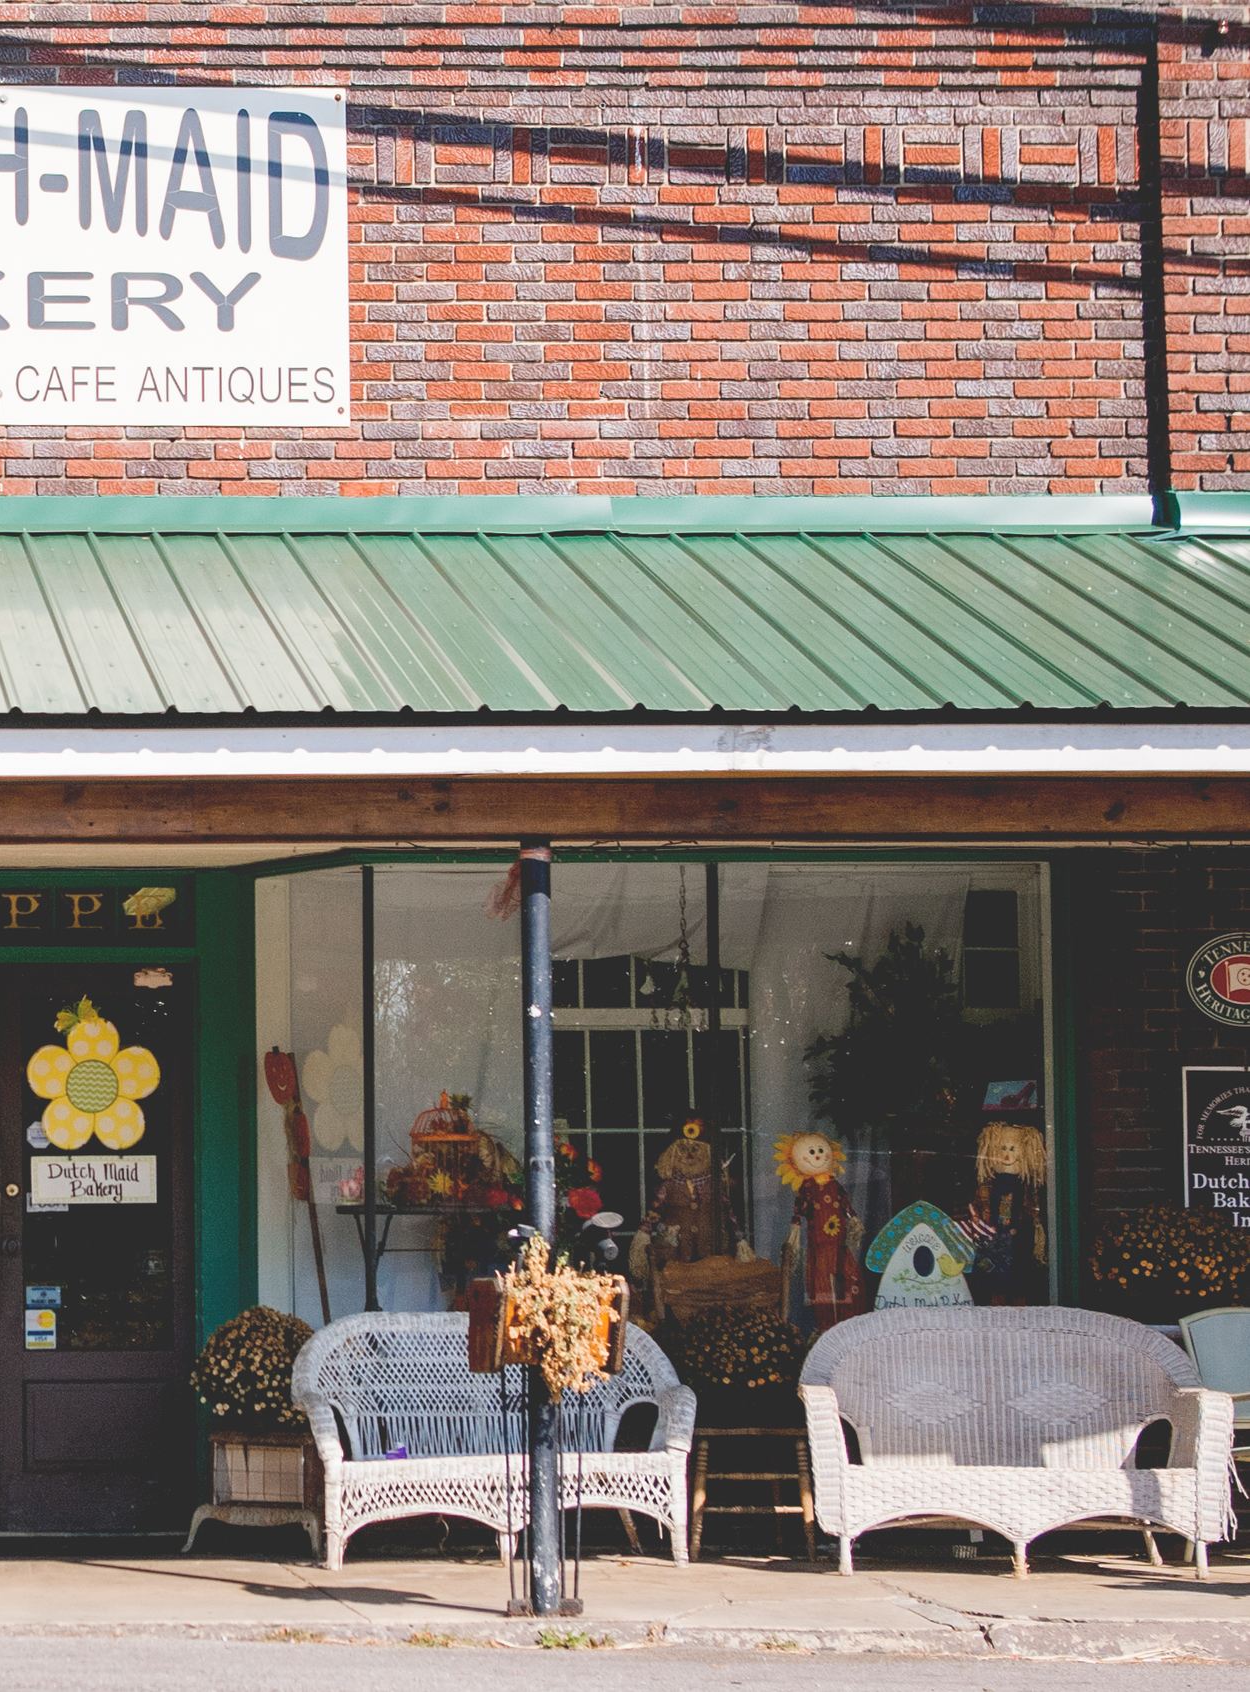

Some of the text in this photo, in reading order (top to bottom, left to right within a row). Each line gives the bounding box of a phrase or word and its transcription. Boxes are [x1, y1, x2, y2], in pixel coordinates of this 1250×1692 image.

[15, 365, 117, 403] CAFE
[138, 366, 336, 405] ANTIQUES
[1200, 1089, 1233, 1122] MEMORIES
[47, 1162, 139, 1183] Dutch Maid
[1192, 1172, 1250, 1189] Dutch
[70, 1179, 124, 1203] Bakery
[1212, 1191, 1250, 1208] Bak
